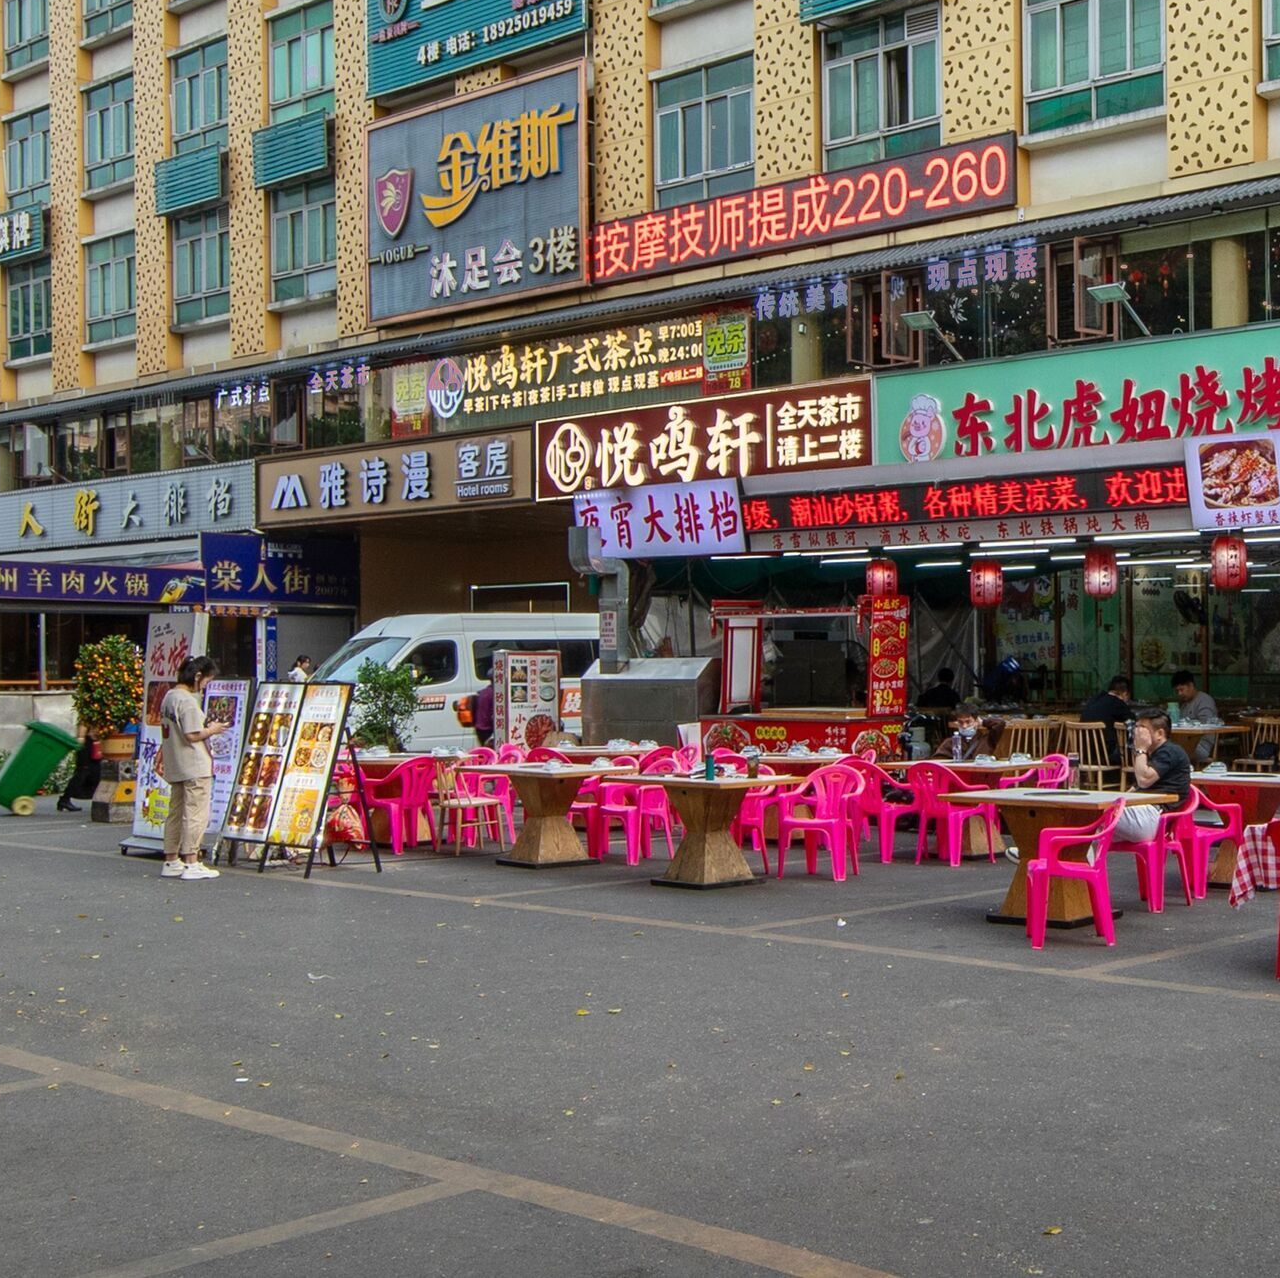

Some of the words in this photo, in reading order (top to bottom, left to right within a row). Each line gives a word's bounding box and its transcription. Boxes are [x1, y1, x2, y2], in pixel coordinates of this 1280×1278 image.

[421, 103, 579, 229] 金维斯
[593, 144, 1008, 278] 按摩技师提成220-260
[380, 245, 415, 265] VOGUE
[429, 238, 523, 299] 沐足会
[528, 225, 578, 274] 3楼
[926, 247, 1039, 292] 现点现蒸
[755, 282, 850, 322] 传统美食
[463, 326, 658, 393] 悦鸣轩广式茶点
[658, 342, 703, 364] 晚24:0
[217, 384, 271, 409] 广式茶点
[308, 364, 371, 394] 全天茶市
[607, 370, 660, 394] 现点现蒸
[776, 392, 863, 432] 全天茶市
[456, 439, 508, 477] 客房
[594, 405, 763, 488] 悦鸣轩
[776, 429, 864, 467] 请上二楼
[319, 451, 432, 510] 雅诗漫
[456, 485, 478, 497] Hotel
[481, 483, 508, 495] rooms
[578, 488, 740, 552] 夜宵大排档
[210, 560, 312, 595] 棠人街
